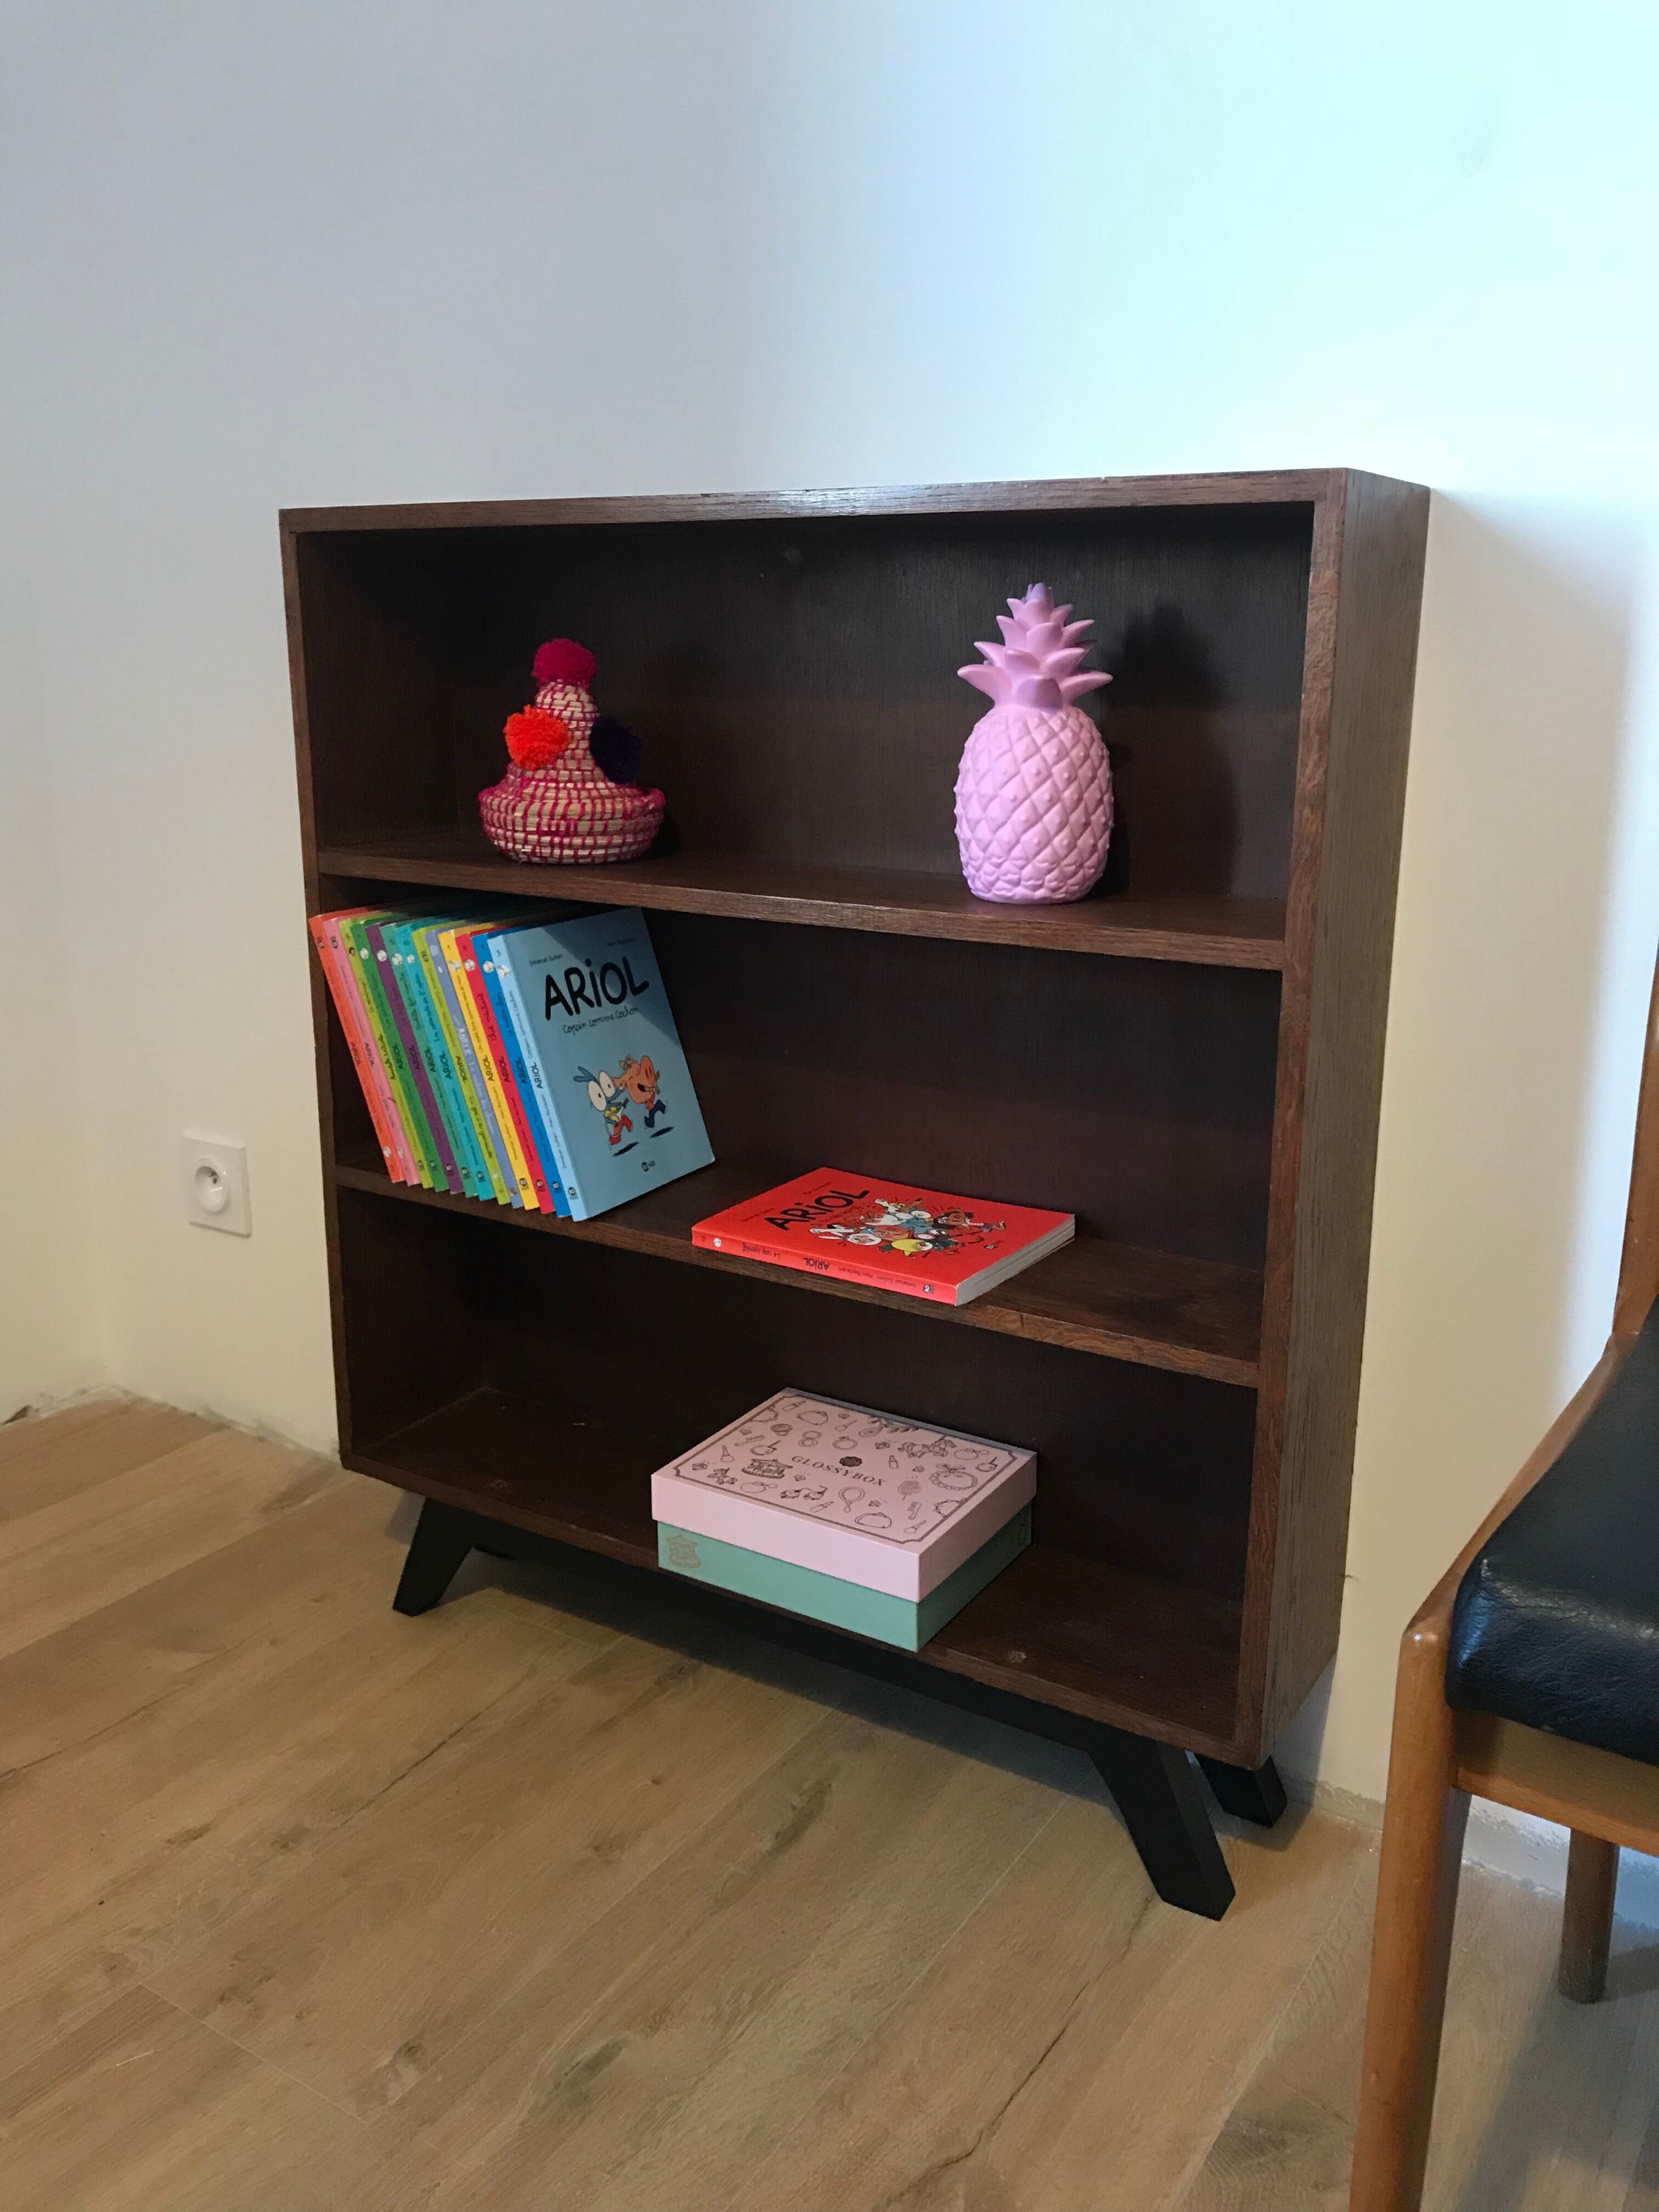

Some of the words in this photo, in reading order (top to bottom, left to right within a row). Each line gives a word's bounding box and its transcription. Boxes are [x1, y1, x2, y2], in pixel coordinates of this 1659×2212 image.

[545, 956, 650, 1020] ARiOL
[562, 1022, 588, 1036] Copain
[589, 1013, 618, 1028] comme
[764, 1189, 870, 1231] ARiOL
[791, 1455, 887, 1486] GLOSSYBOX
